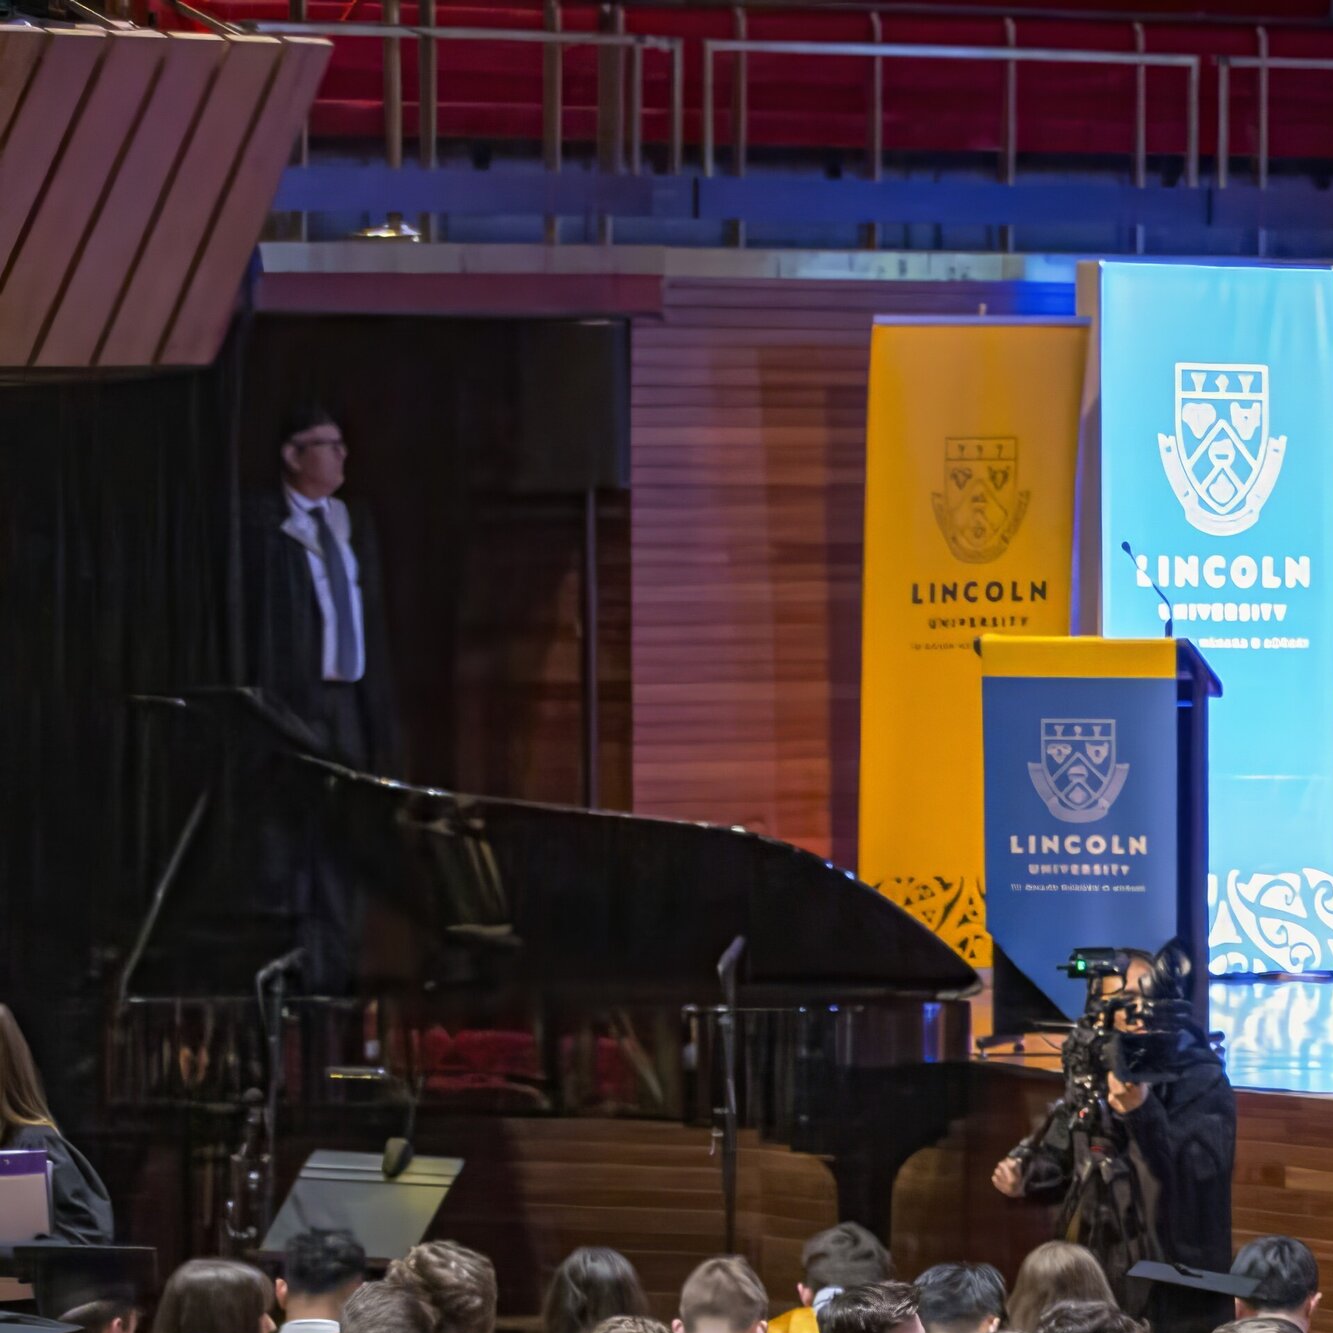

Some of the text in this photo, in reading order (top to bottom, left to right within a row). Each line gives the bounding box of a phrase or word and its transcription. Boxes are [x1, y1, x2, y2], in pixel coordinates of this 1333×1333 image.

[1135, 554, 1311, 589] LINCOLN
[911, 581, 1047, 605] LINCOLN
[1010, 834, 1147, 855] LINCOLN
